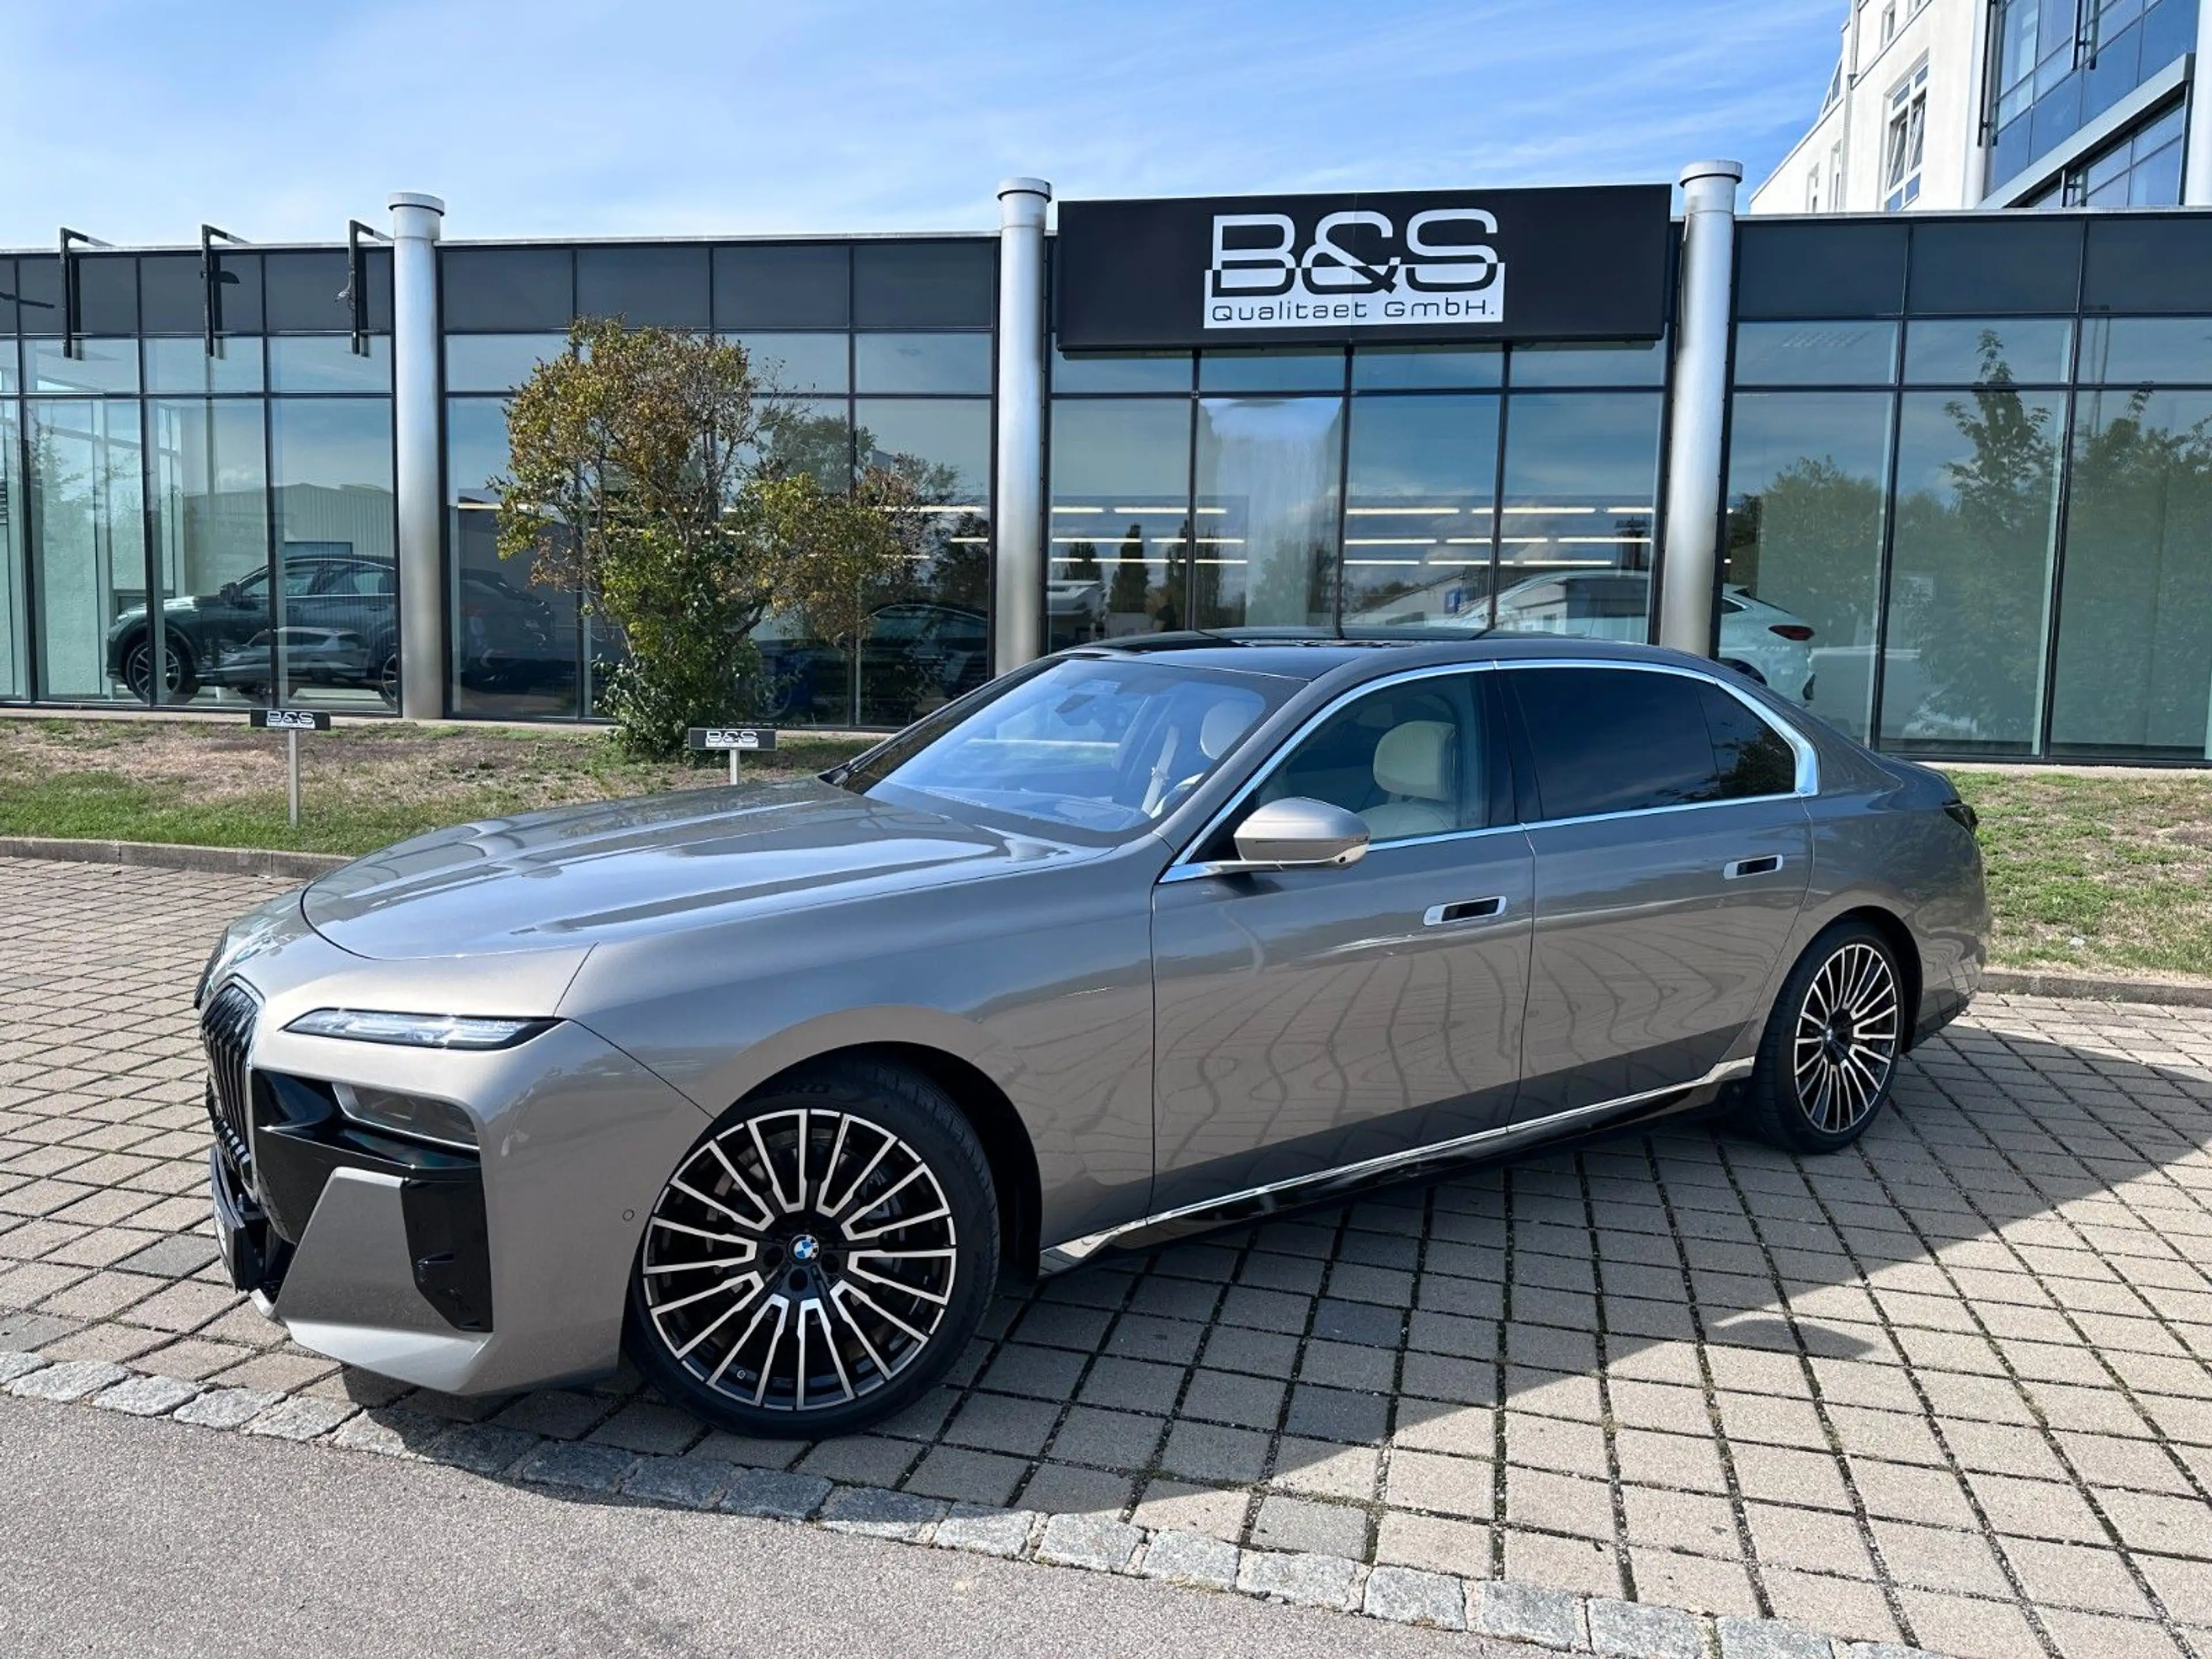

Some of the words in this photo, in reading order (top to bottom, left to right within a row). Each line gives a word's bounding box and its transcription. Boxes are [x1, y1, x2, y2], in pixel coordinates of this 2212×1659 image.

[1211, 208, 1498, 298] B&S
[1211, 300, 1368, 321] Qualitaet
[1384, 297, 1495, 318] GmbH.
[267, 710, 314, 724] B&S
[706, 730, 757, 743] B&S
